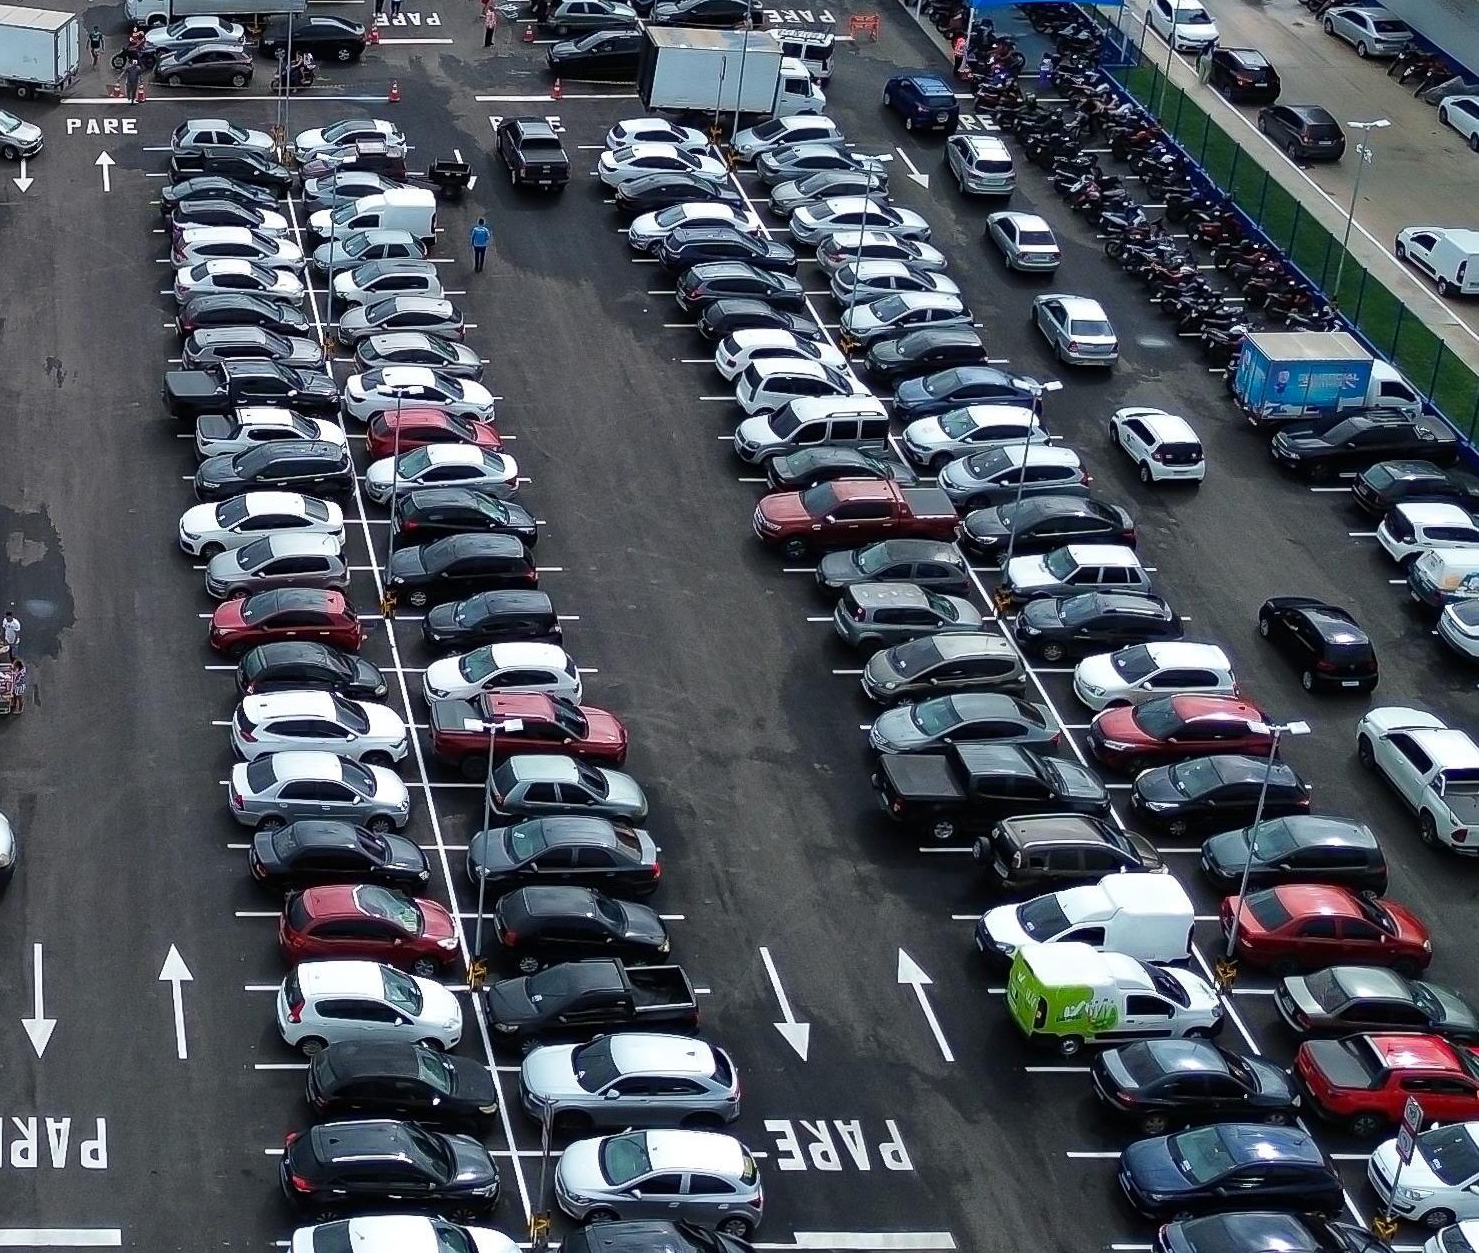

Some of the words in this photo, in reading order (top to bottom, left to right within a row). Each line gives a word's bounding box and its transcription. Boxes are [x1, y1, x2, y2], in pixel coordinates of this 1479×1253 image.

[373, 12, 441, 26] PARE
[763, 9, 836, 23] PARE
[66, 118, 138, 134] PARE
[763, 1119, 914, 1171] PARE
